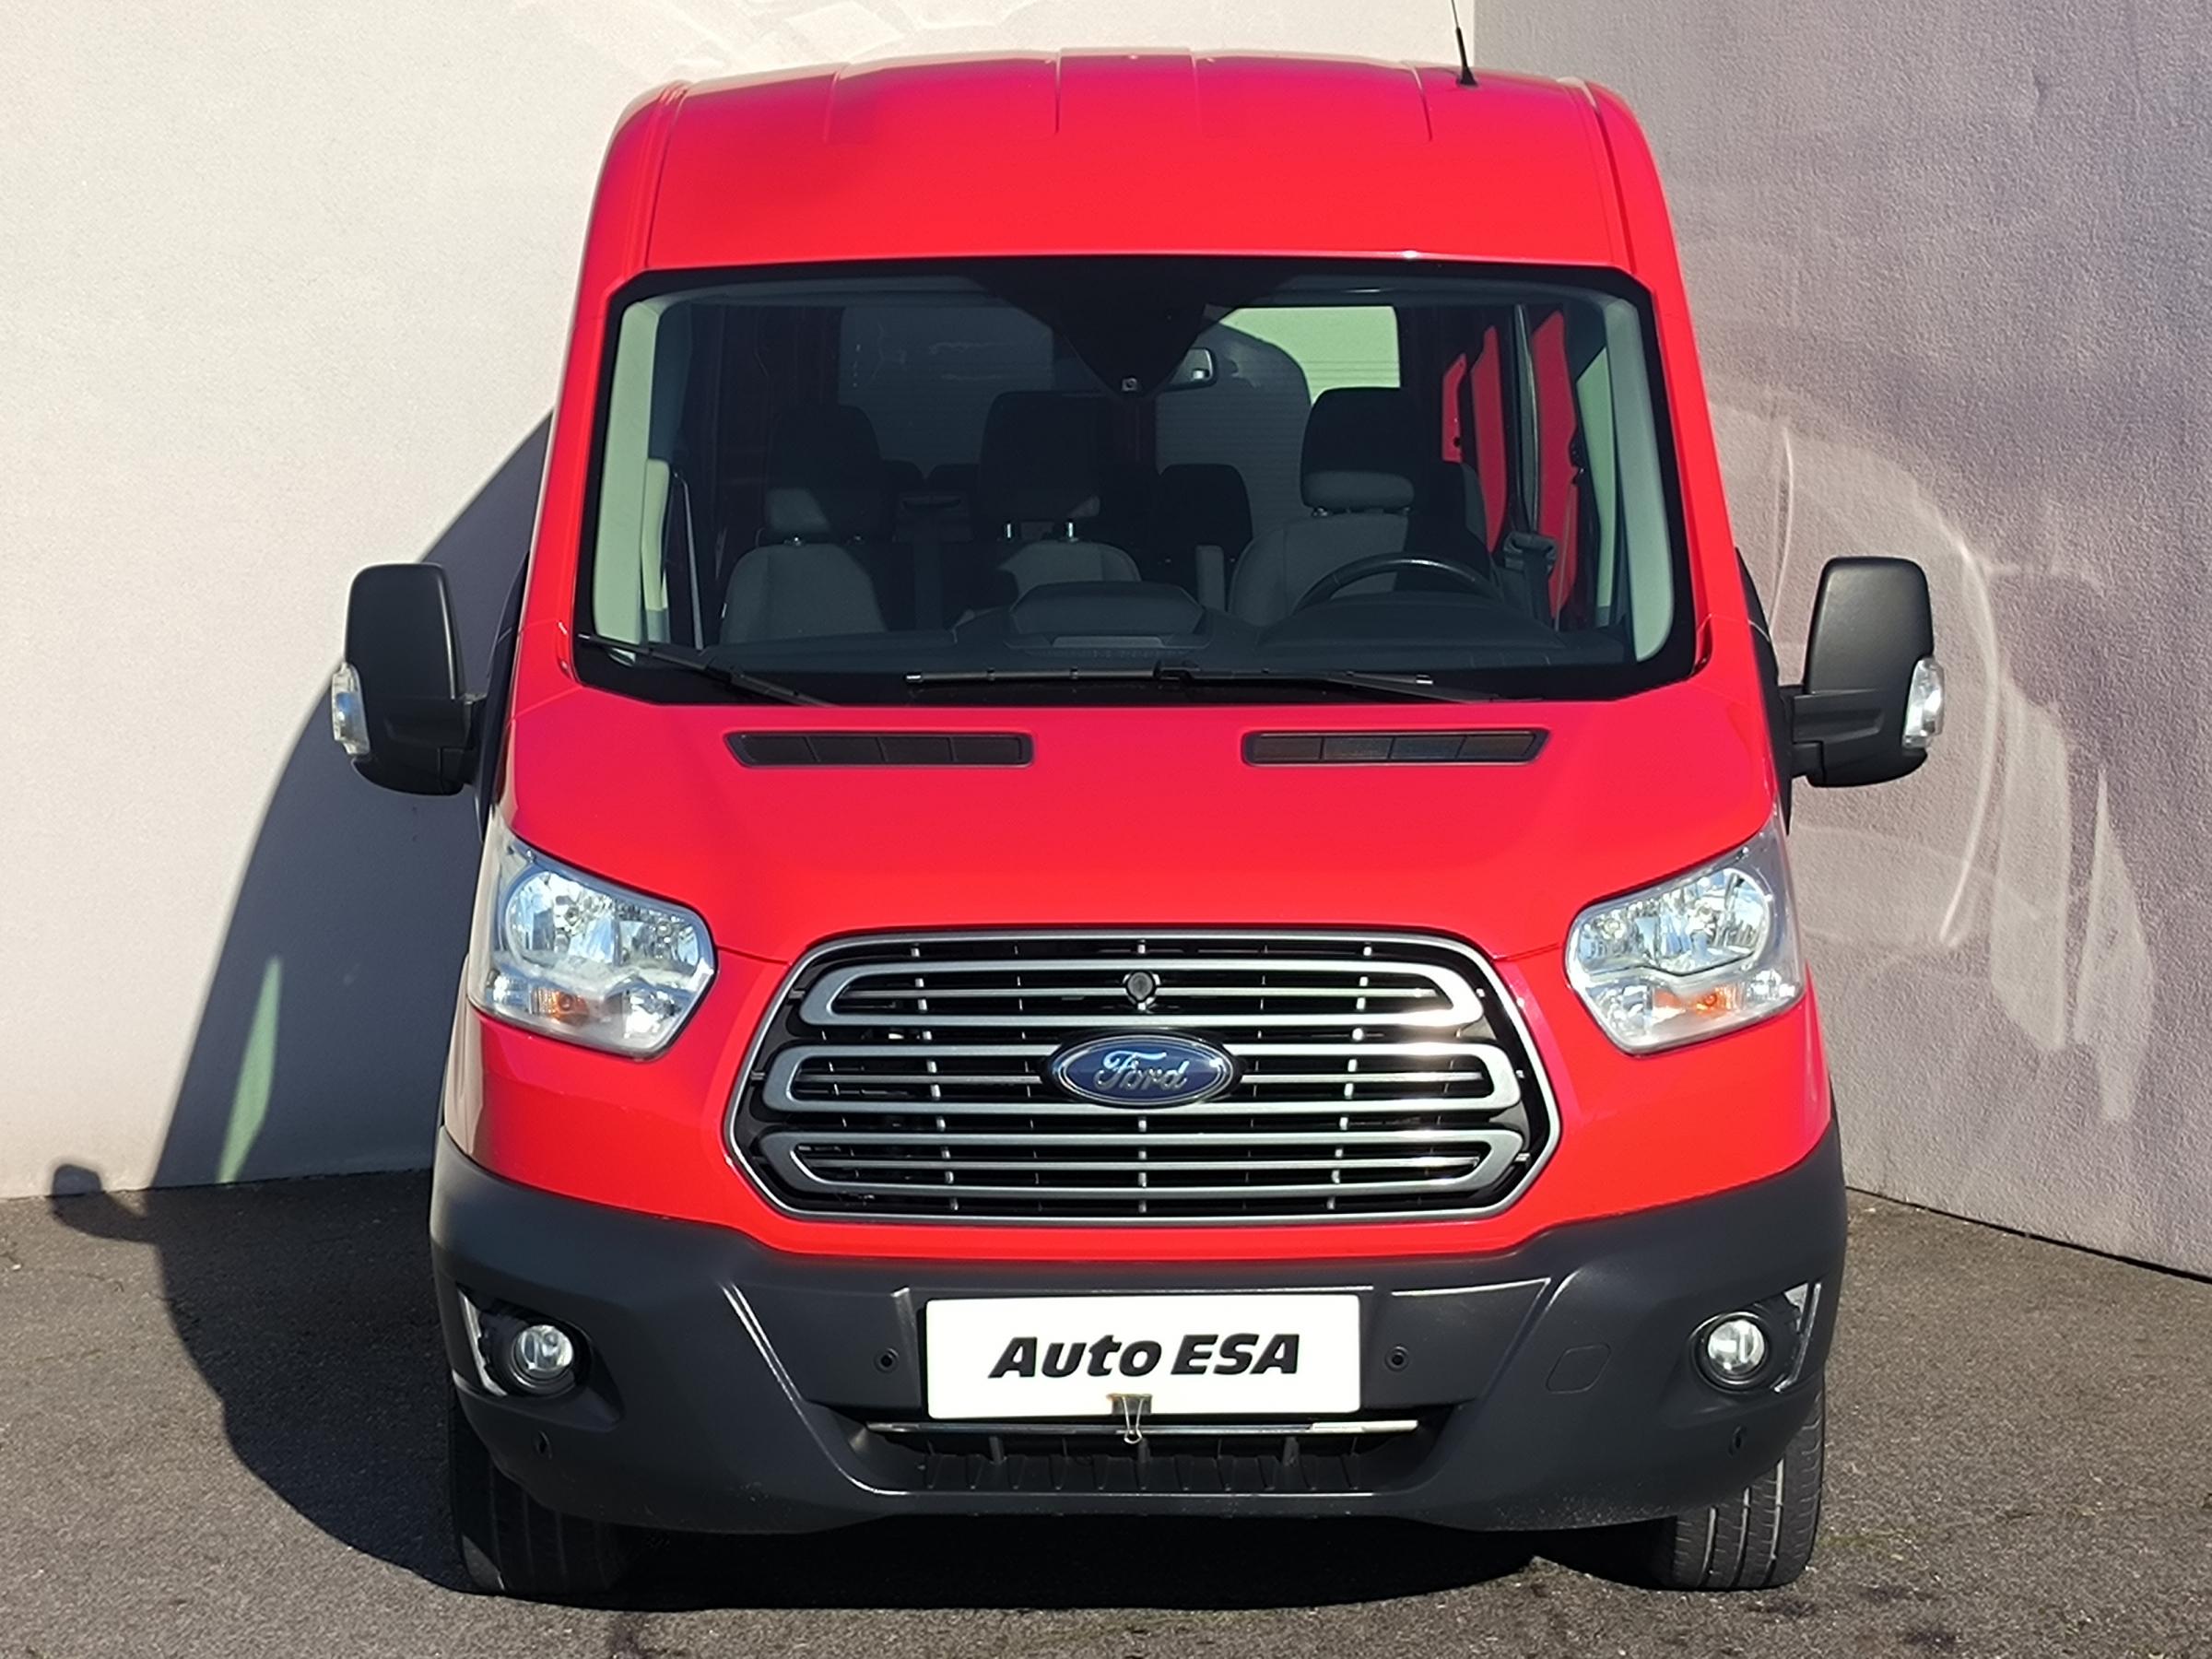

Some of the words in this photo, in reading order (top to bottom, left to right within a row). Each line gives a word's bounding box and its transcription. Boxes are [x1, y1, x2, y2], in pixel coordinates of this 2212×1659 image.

[1093, 1050, 1190, 1091] Ford
[988, 1335, 1161, 1378] Auto
[1171, 1333, 1300, 1374] ESA
